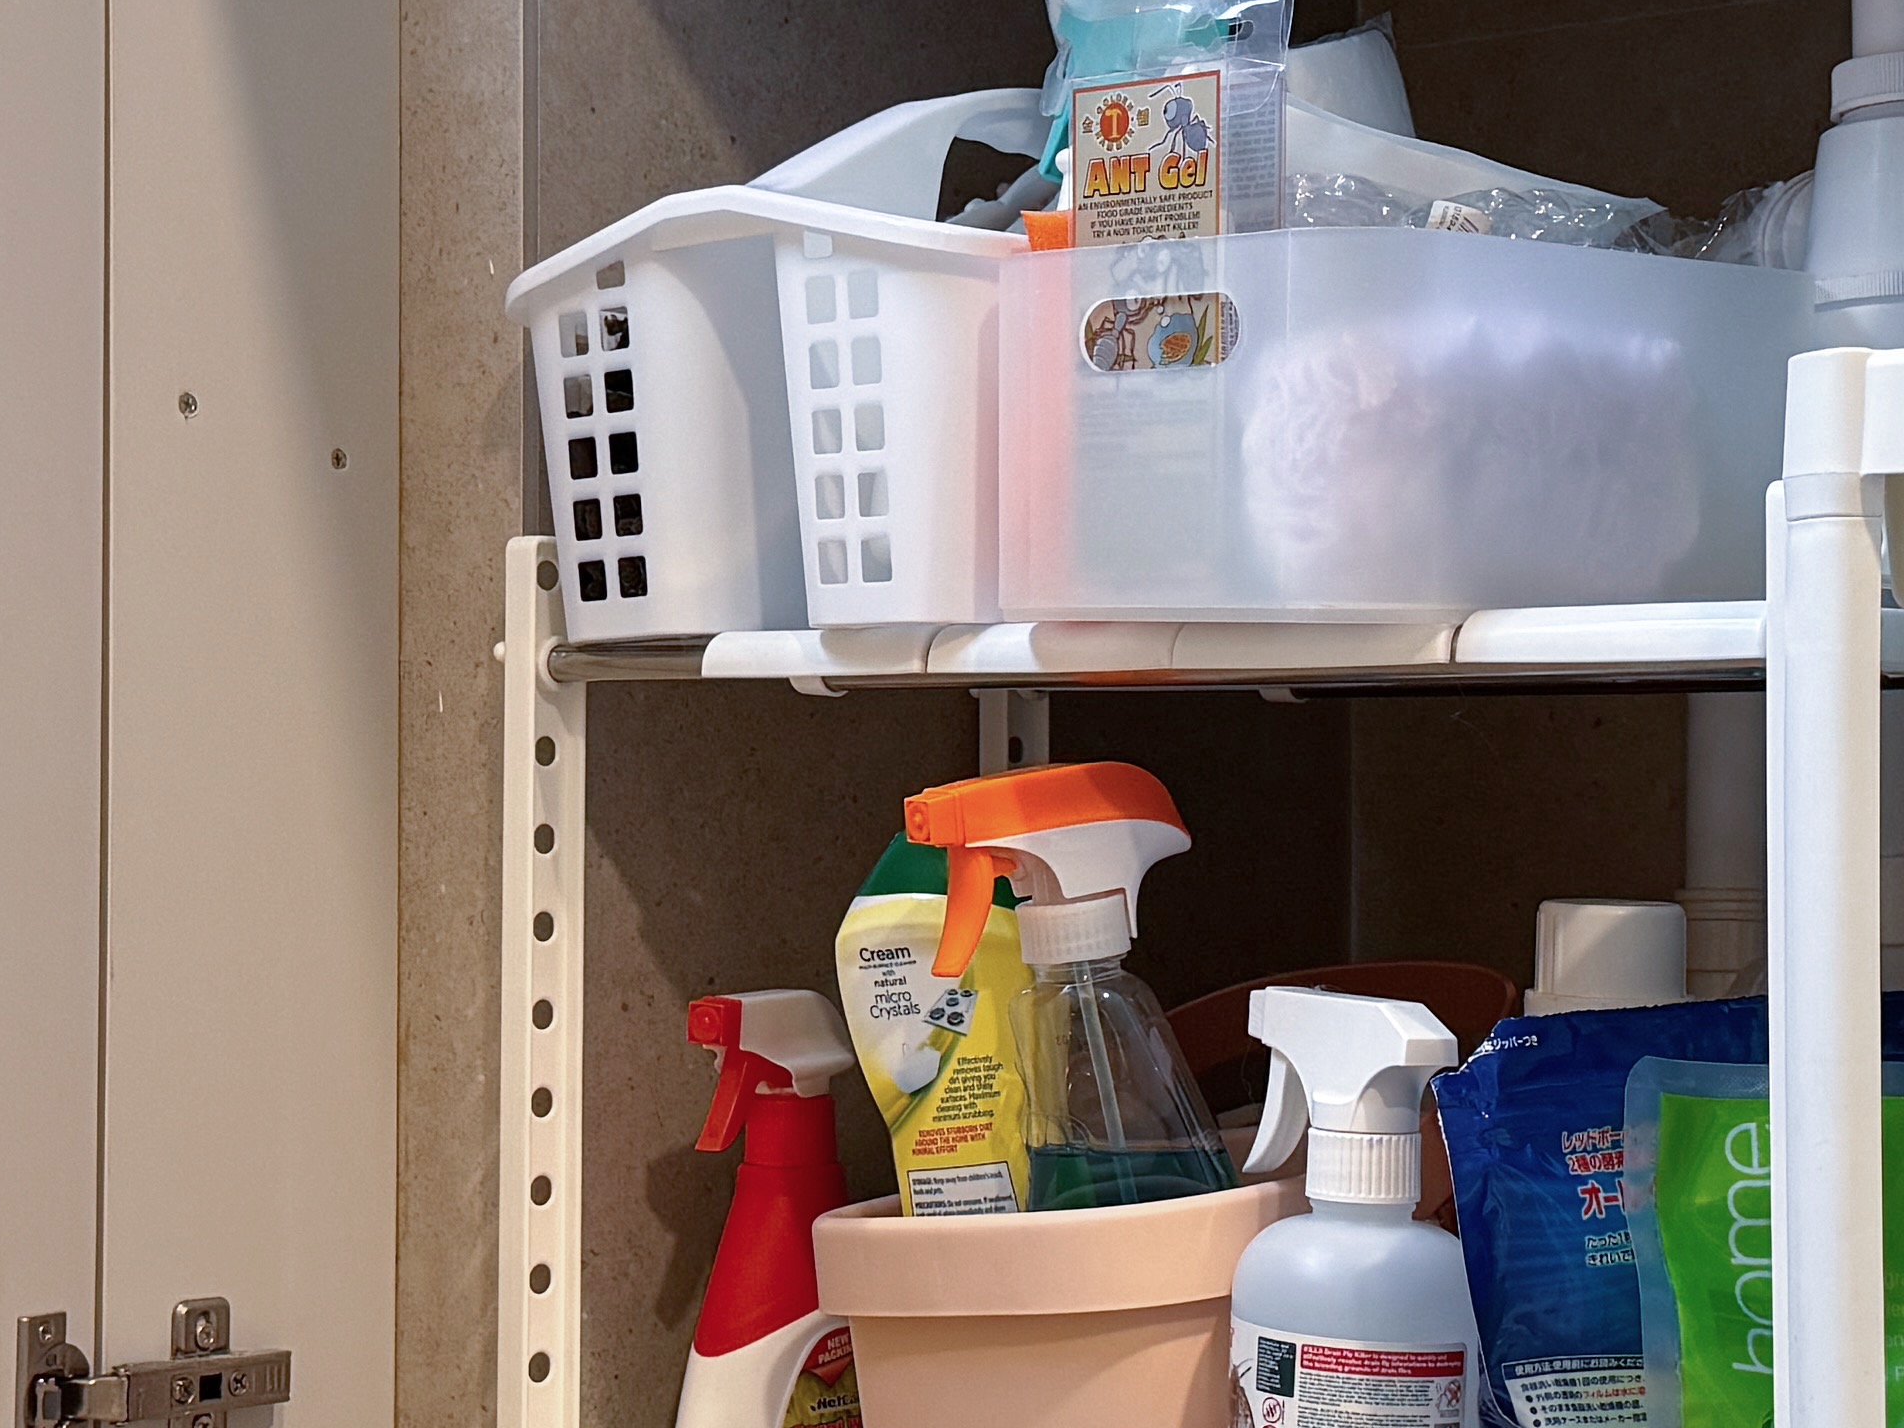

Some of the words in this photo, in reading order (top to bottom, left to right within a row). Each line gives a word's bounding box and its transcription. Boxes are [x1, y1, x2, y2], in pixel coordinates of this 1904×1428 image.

[1083, 153, 1151, 199] ANT
[1158, 149, 1209, 191] Gel
[1090, 195, 1156, 210] ENVIRONMENTALLY
[1178, 190, 1213, 201] PRODUCT
[859, 947, 912, 962] Cream
[874, 976, 907, 988] natural
[875, 990, 912, 1004] micro
[870, 1003, 921, 1020] Crystals
[1562, 1126, 1625, 1153] レッドボー
